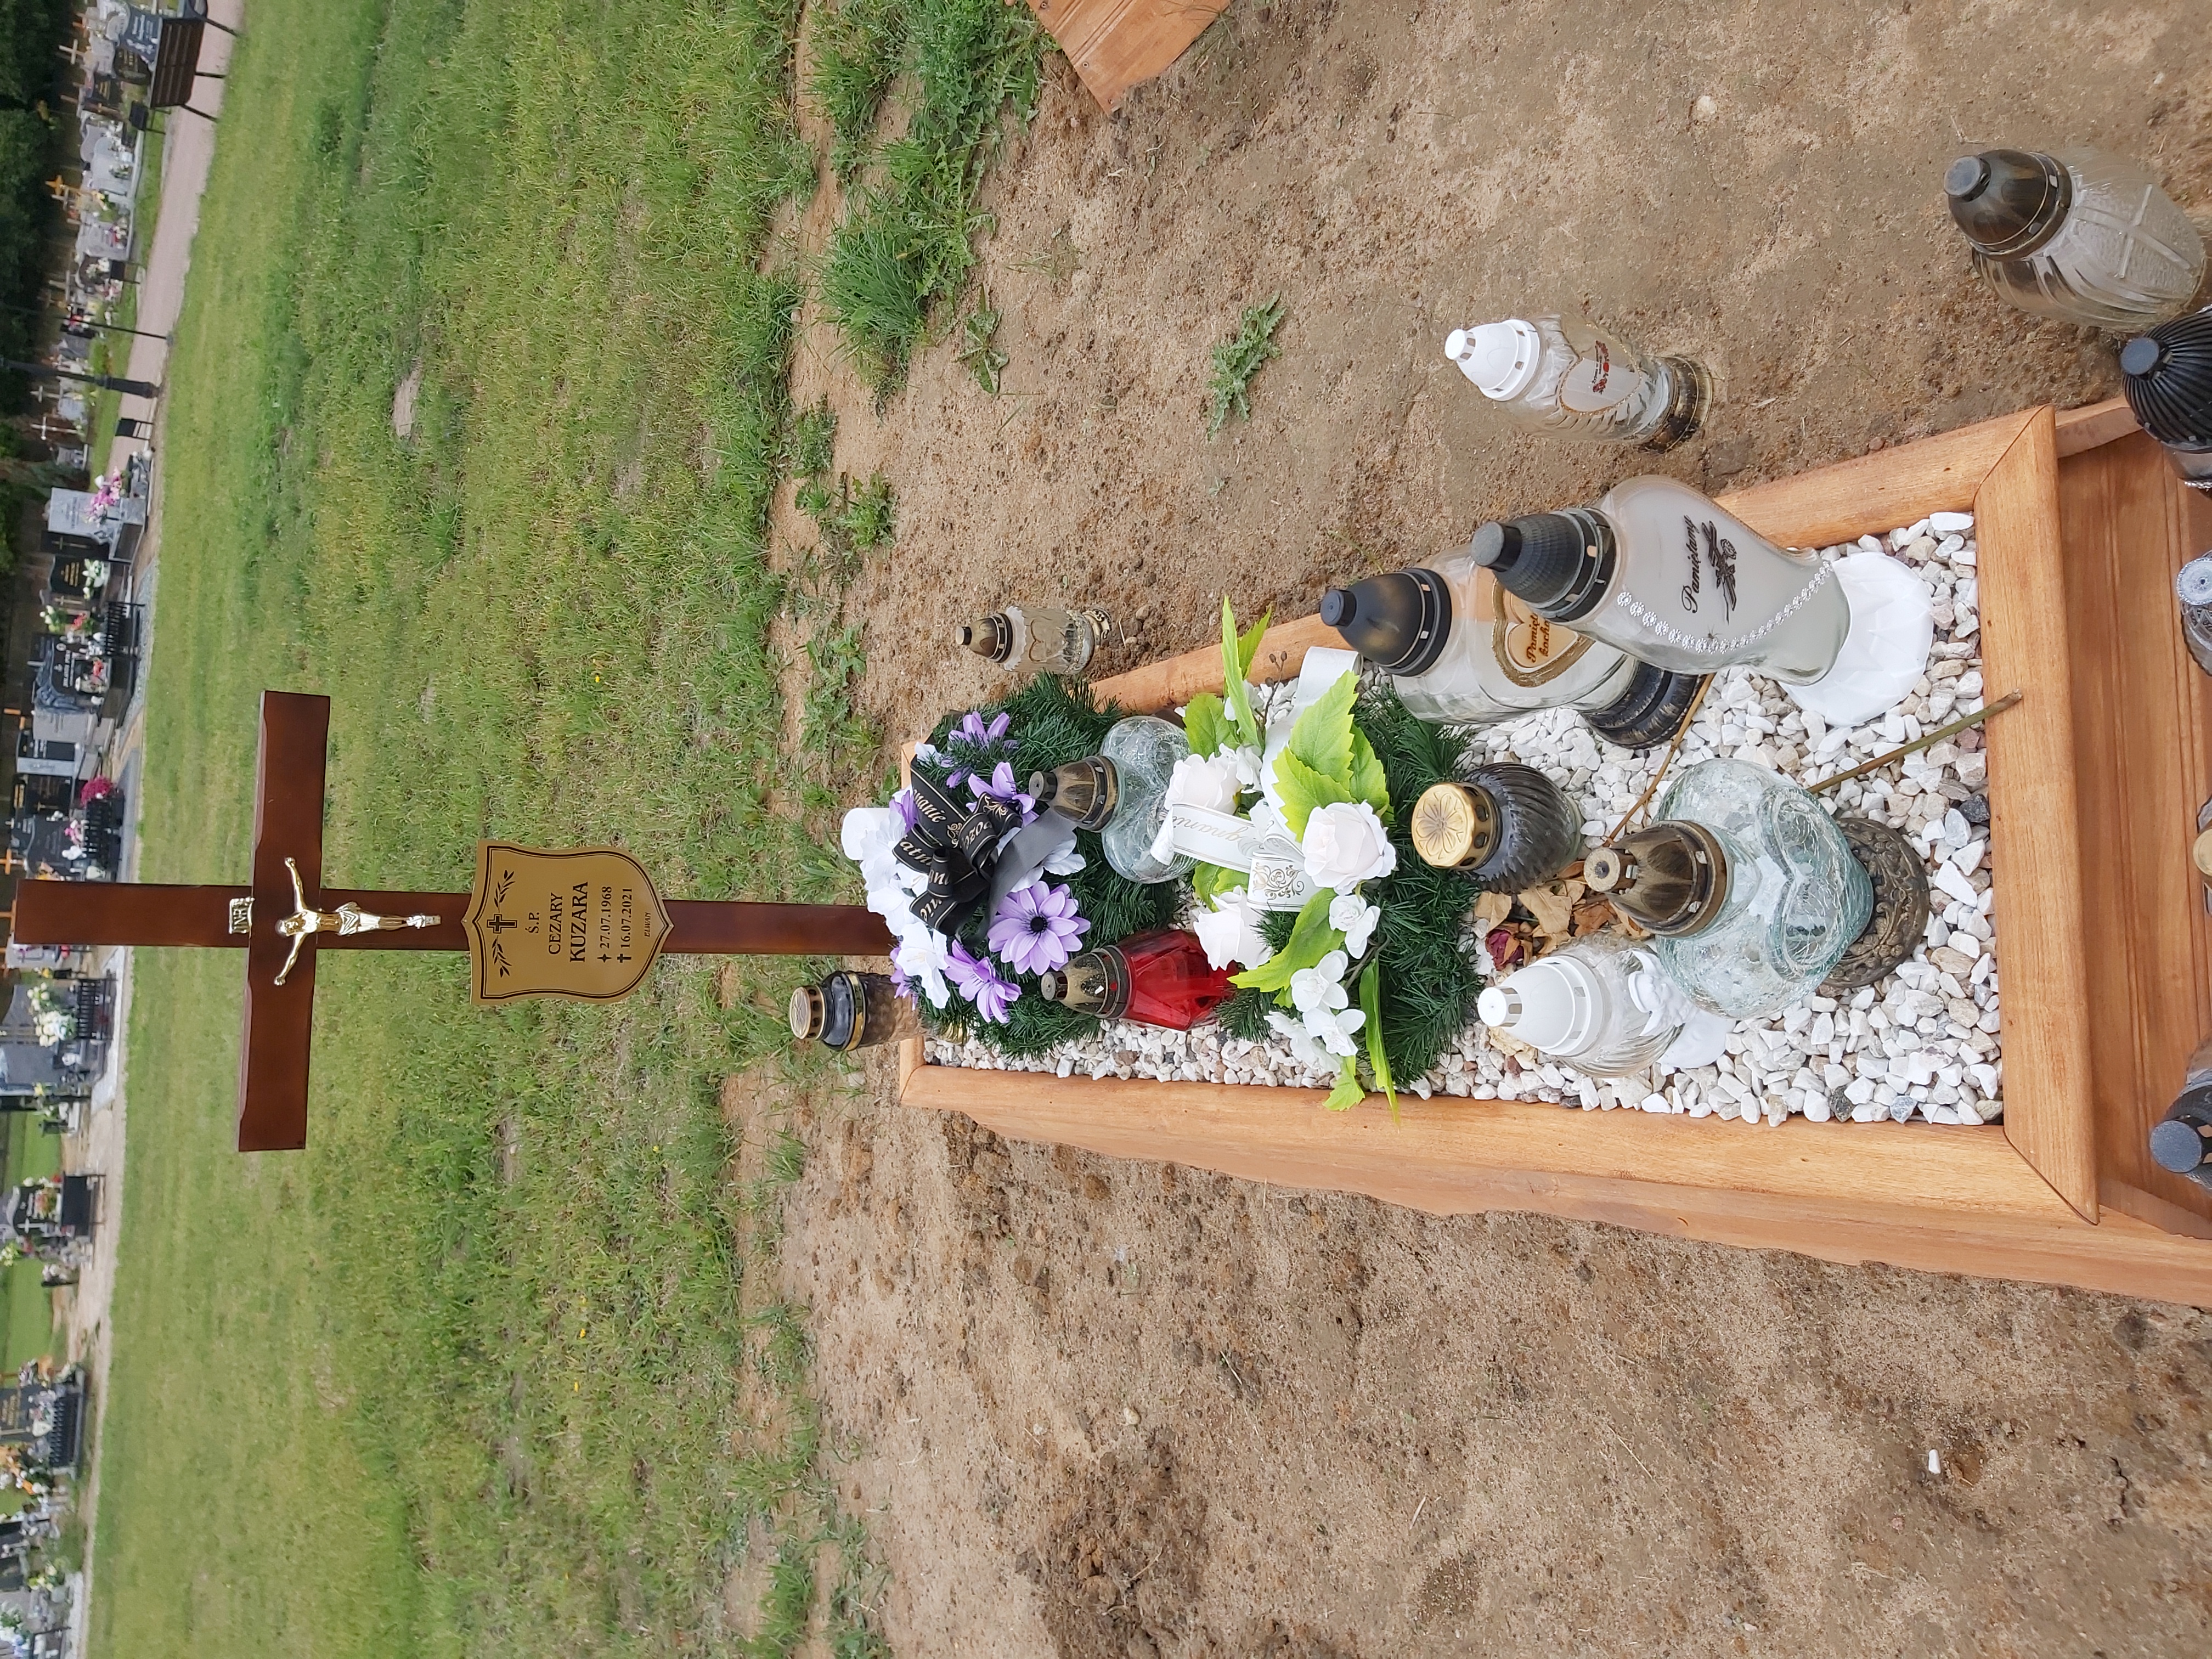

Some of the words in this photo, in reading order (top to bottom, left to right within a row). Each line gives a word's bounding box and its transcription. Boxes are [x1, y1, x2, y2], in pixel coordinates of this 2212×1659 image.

[1681, 515, 1701, 614] Pamiętamy
[524, 912, 540, 934] Ś.P.
[548, 892, 563, 955] CEZARY
[569, 882, 588, 963] KUZARA
[600, 886, 612, 949] 27.07.1968
[620, 888, 632, 949] 16.07.2021
